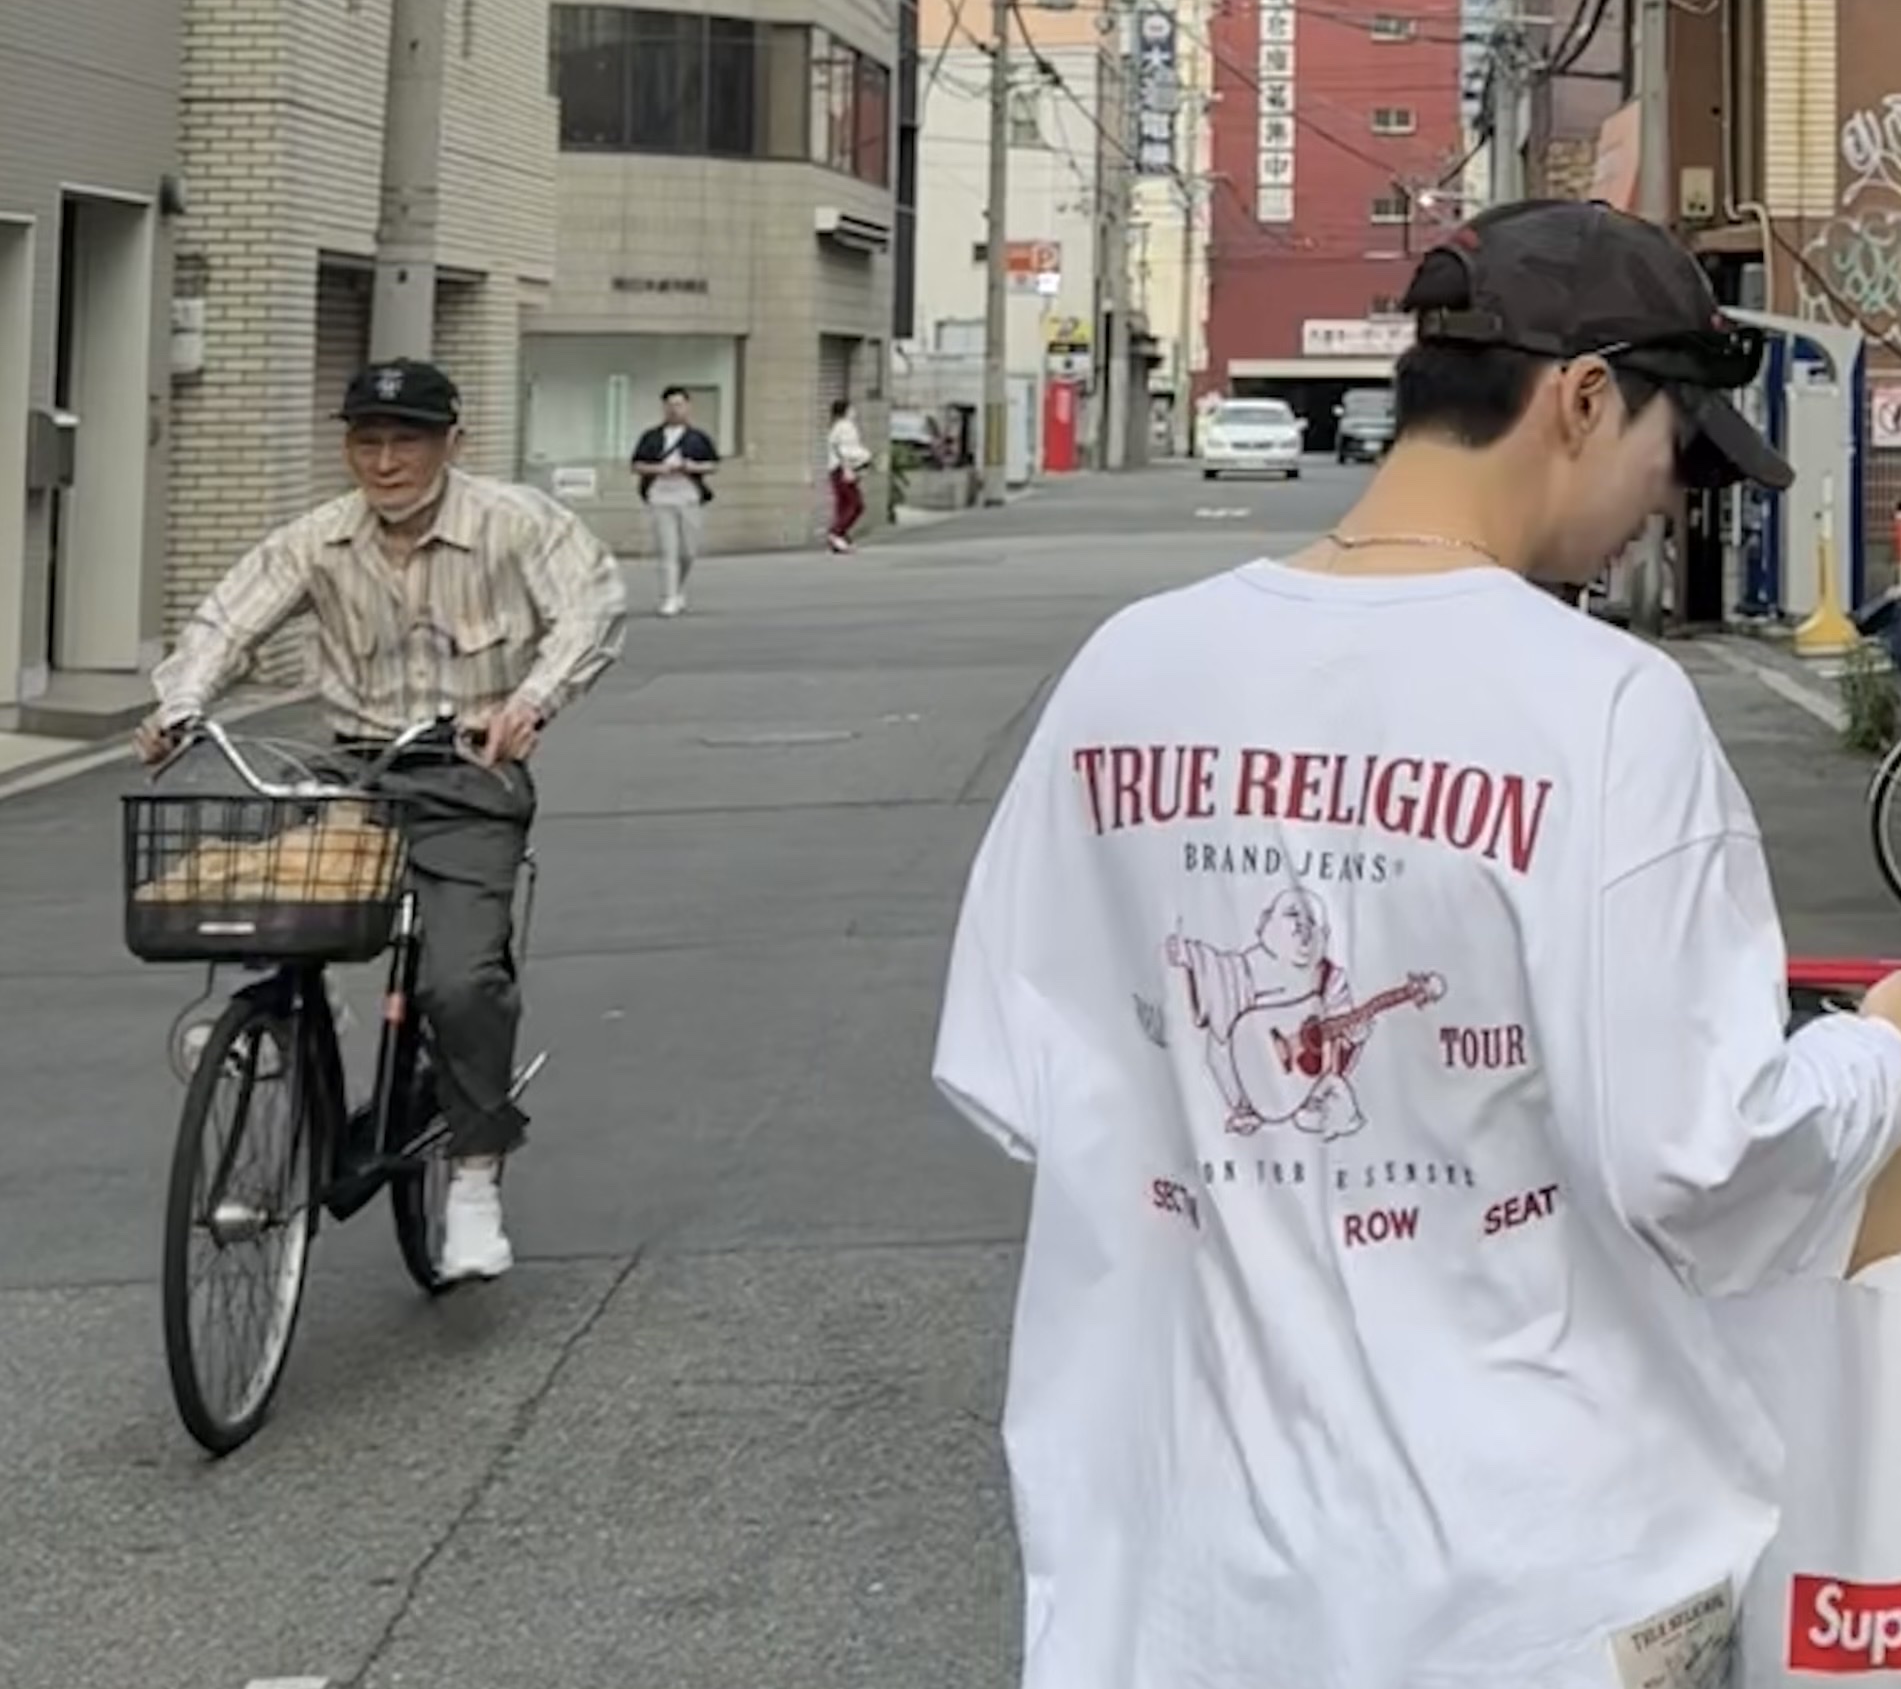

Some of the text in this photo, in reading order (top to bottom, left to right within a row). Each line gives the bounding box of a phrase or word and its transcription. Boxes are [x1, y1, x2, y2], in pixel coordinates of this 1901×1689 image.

[1074, 745, 1553, 874] TRUE RELIGION
[1184, 843, 1386, 882] BRAND JEANS
[1439, 1026, 1526, 1070] TOUR
[1344, 1208, 1419, 1247] ROW
[1482, 1183, 1560, 1236] SEAT
